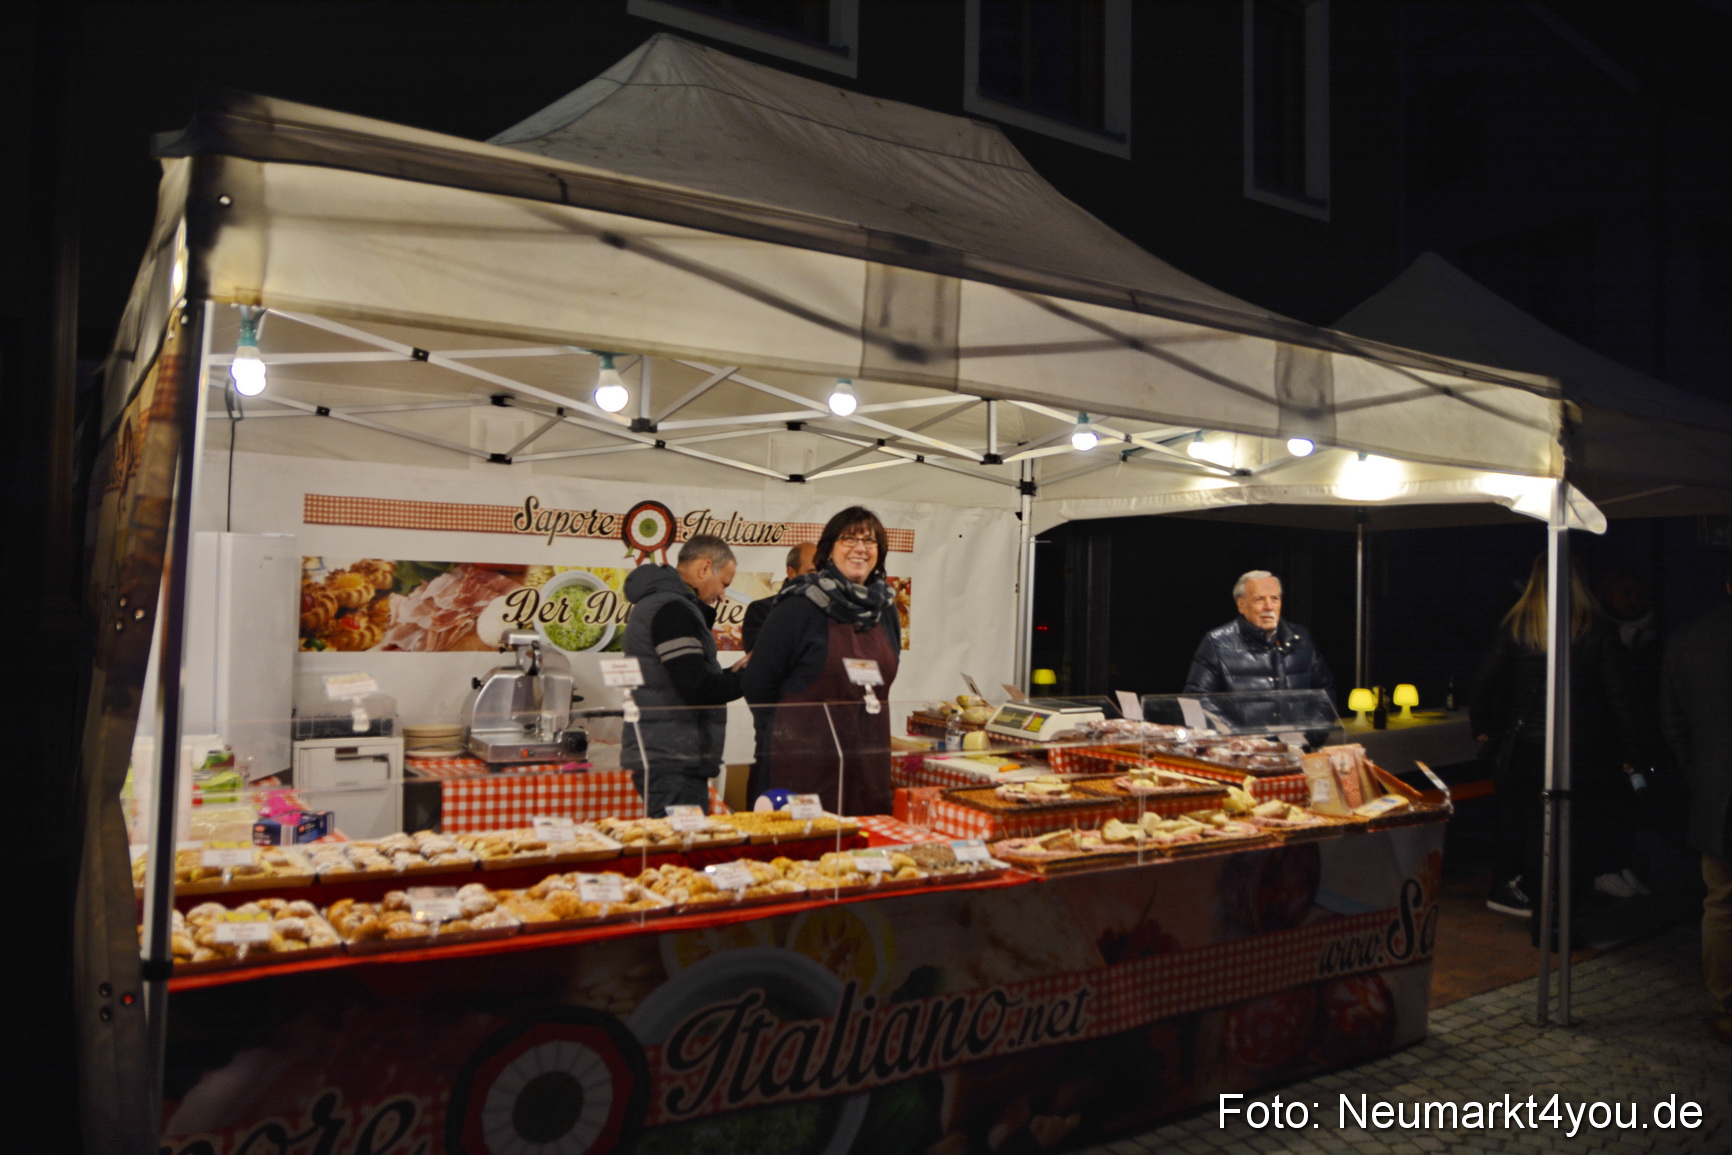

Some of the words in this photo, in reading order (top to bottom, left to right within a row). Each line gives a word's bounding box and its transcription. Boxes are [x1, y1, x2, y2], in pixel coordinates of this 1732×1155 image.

[514, 496, 616, 546] Sapore
[682, 509, 789, 544] Italiano
[502, 588, 573, 624] Der
[584, 590, 636, 624] Du
